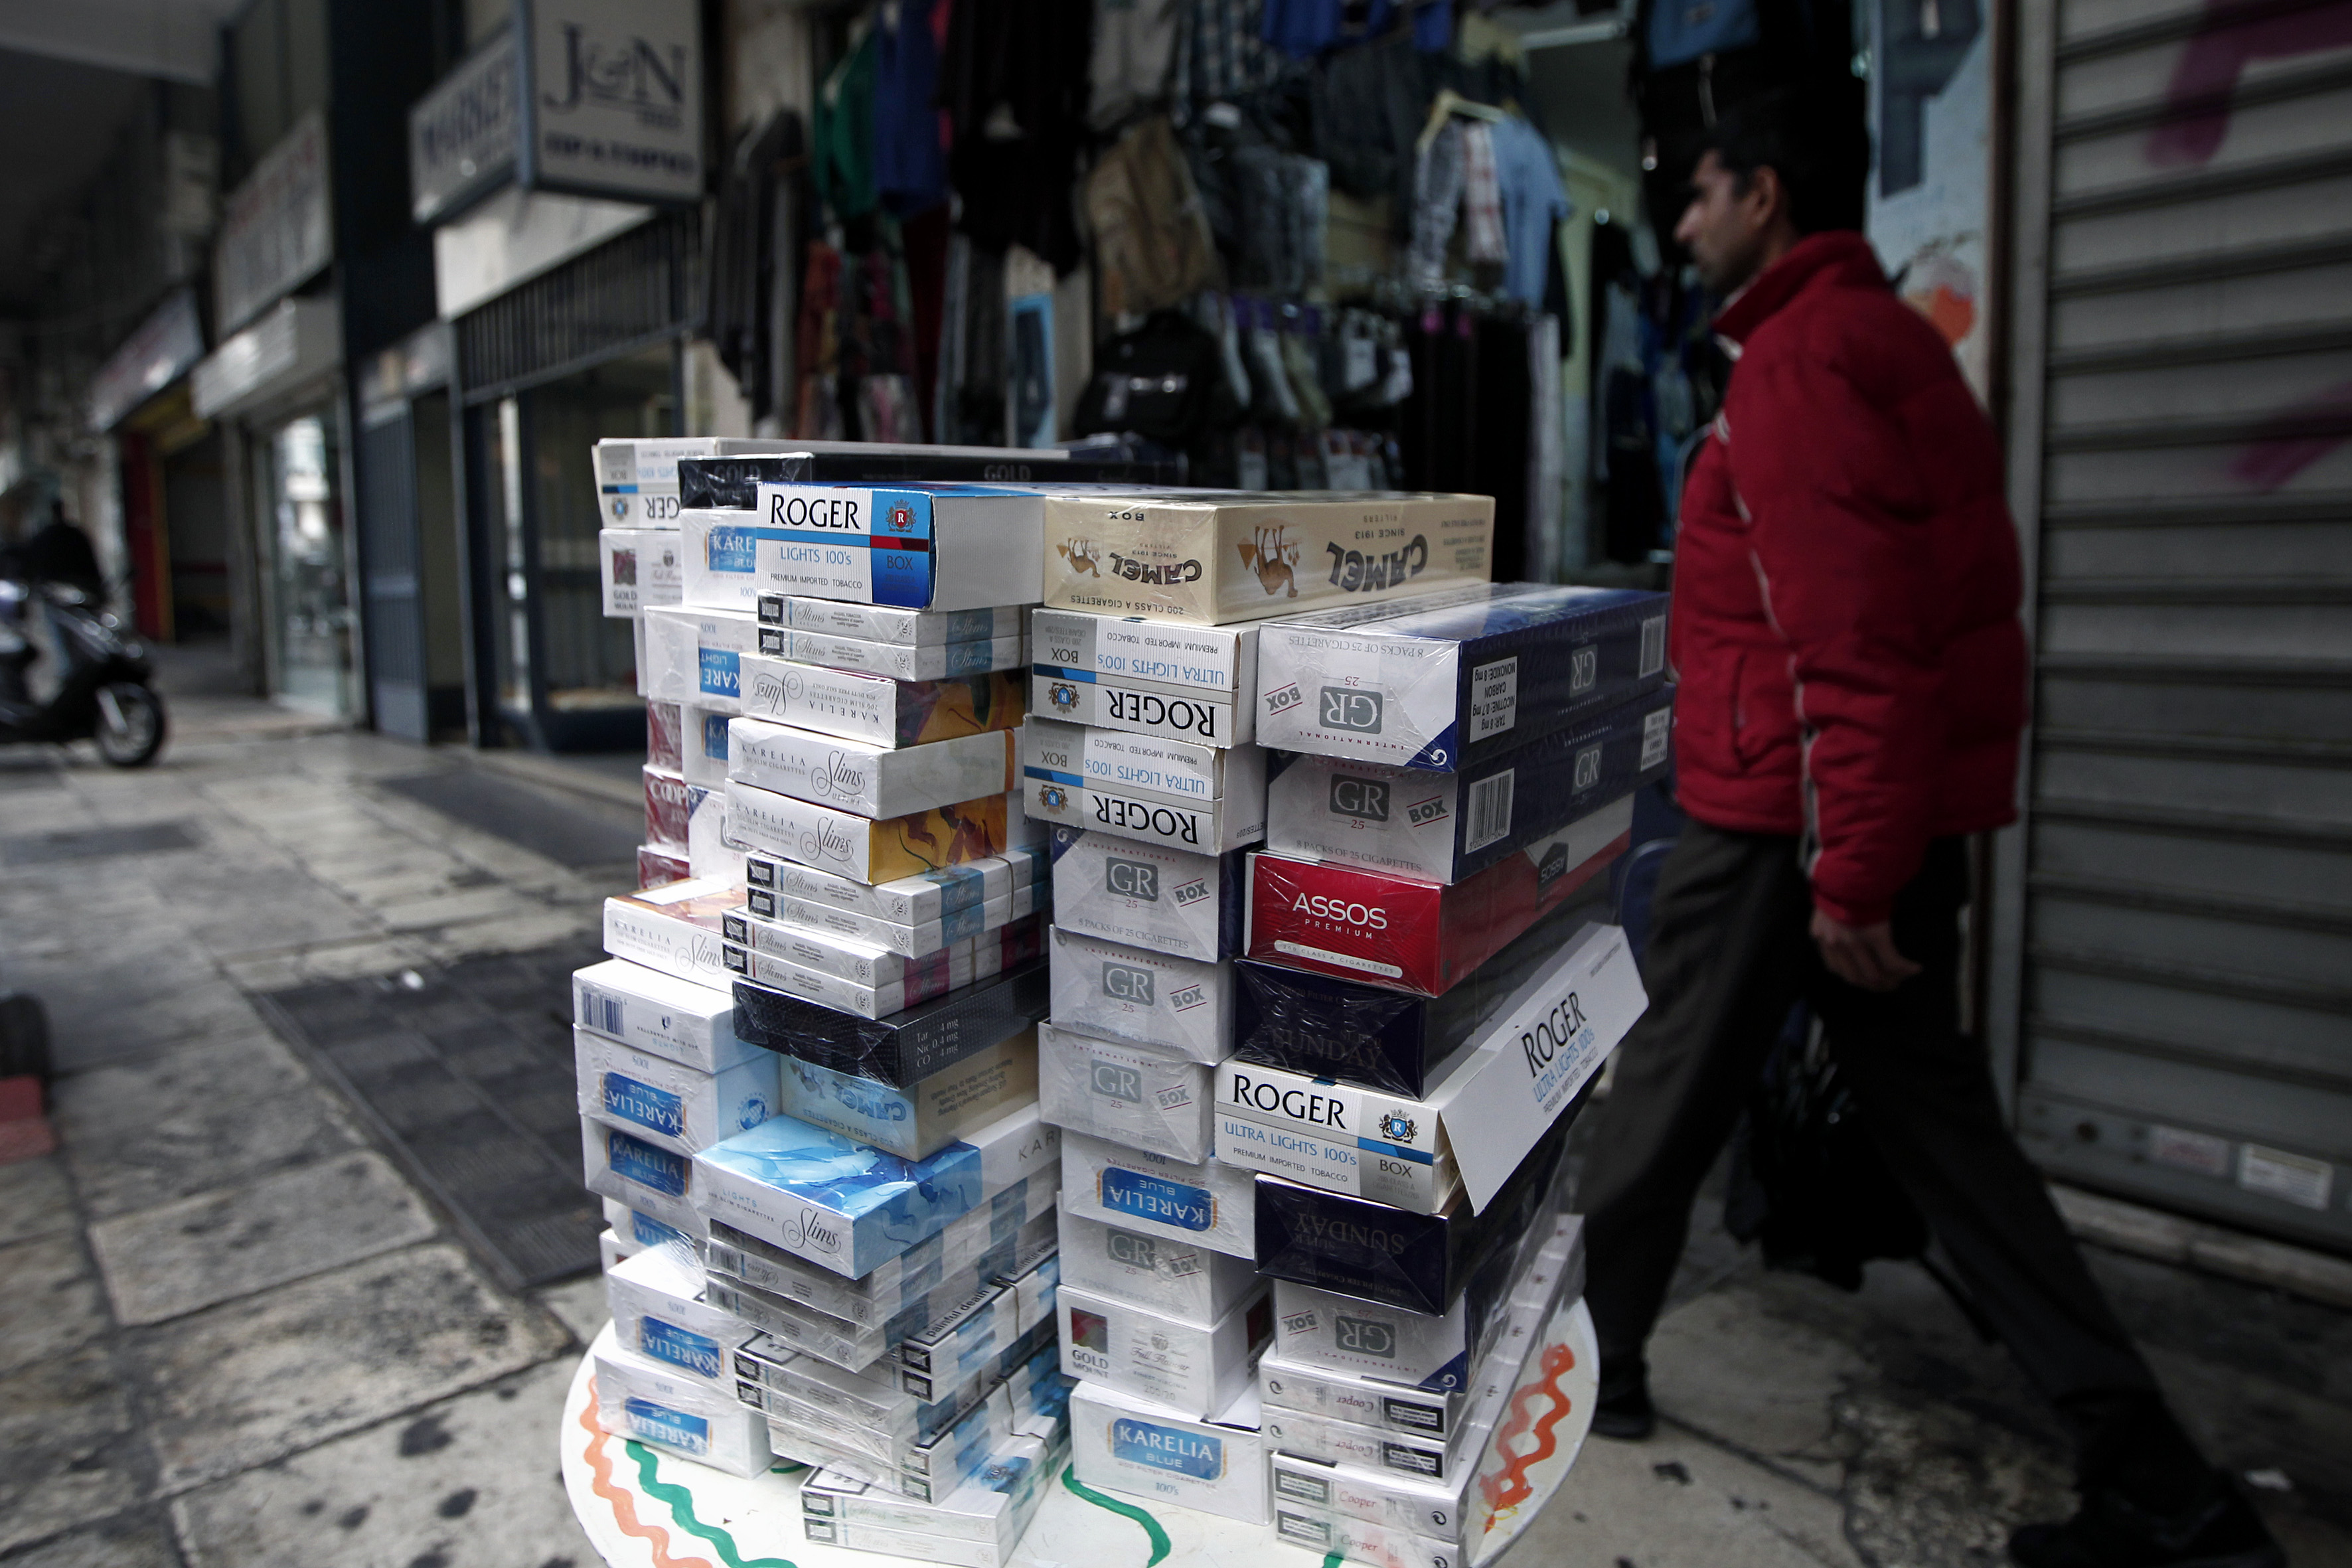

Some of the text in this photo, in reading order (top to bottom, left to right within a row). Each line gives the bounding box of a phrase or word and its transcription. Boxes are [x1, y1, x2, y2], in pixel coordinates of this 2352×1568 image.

[984, 464, 1031, 481] GOLD
[770, 493, 861, 530] ROGER
[1110, 512, 1145, 521] BOX
[1355, 528, 1405, 540] SINCE 1913
[780, 546, 852, 565] LIGHTS 100's
[886, 555, 914, 570] BOX
[1326, 533, 1429, 592] CAMEL
[1109, 552, 1203, 585] CAMEL
[770, 573, 862, 589] PREMIUM IMPORTED TOBACCO
[1070, 594, 1123, 607] CIGARETTES
[1135, 603, 1164, 612] CLASS
[1166, 605, 1184, 615] 200
[1051, 647, 1079, 663] BOX
[1107, 631, 1219, 655] PREMIUM IMPORTED TOBACCO
[1289, 635, 1424, 658] 8 PACKS OF 25 CIGARETTES
[1097, 653, 1225, 685] ULTRA LIGHTS 100's
[1488, 662, 1516, 678] MONOXIDE:
[1572, 651, 1597, 690] GR
[752, 670, 804, 716] Slims
[1344, 676, 1360, 687] 25
[1484, 681, 1507, 696] CARBON
[809, 691, 848, 706] CIGARETTES
[1265, 686, 1302, 712] BOX
[1324, 691, 1378, 728] GR
[1490, 696, 1516, 715] NICOTINE:
[808, 700, 880, 724] KARELIA
[1105, 690, 1216, 738] ROGER
[1494, 714, 1506, 727] TAR:
[1094, 739, 1198, 765] PREMIUM IMPORTED TOBACCO
[1298, 730, 1405, 751] INTERNATIONAL
[742, 744, 806, 767] KARELIA
[1042, 751, 1067, 767] BOX
[769, 761, 806, 776] CIGARETTES
[811, 750, 866, 797] Slims
[1085, 758, 1206, 794] ULTRA LIGHTS 100's
[1575, 751, 1601, 789] GR
[1333, 779, 1385, 817] GR
[736, 801, 795, 830] KARELIA
[1092, 794, 1199, 845] ROGER
[1408, 799, 1449, 823] BOX
[1350, 819, 1366, 830] 25
[800, 816, 854, 862] Slims
[1087, 841, 1176, 862] INTERNATIONAL
[1303, 840, 1423, 872] PACKS OF 25 CIGARETTES
[1110, 862, 1156, 898] GR
[1125, 899, 1138, 909] 25
[1175, 882, 1209, 903] BOX
[1292, 892, 1388, 930] ASSOS
[1084, 919, 1189, 949] PACKS OF 25 CIGARETTES
[1304, 917, 1373, 939] PREMIUM
[674, 933, 723, 975] Slims
[1085, 947, 1173, 969] INTERNATIONAL
[1300, 947, 1394, 974] CLASS CIGARETTES
[1106, 967, 1150, 1002] GR
[1121, 1003, 1135, 1013] 25
[1171, 987, 1206, 1008] BOX
[916, 1018, 959, 1044] Tar mg
[1521, 990, 1587, 1079] ROGER
[916, 1031, 959, 1056] Nic 0.4 mg
[917, 1044, 959, 1068] CO mg
[1073, 1044, 1159, 1069] INTERNATIONAL
[1095, 1065, 1138, 1100] GR
[1533, 1071, 1557, 1103] ULTRA
[1555, 1042, 1579, 1080] LIGHTS
[831, 1080, 907, 1122] CAMEL
[1110, 1099, 1123, 1109] 25
[1158, 1087, 1190, 1107] BOX
[1232, 1073, 1347, 1130] ROGER
[607, 1089, 678, 1132] KARELIA
[854, 1127, 878, 1142] CLASS
[1225, 1121, 1358, 1166] ULTRA LIGHTS 100's
[613, 1139, 679, 1180] KARELIA
[1143, 1150, 1166, 1165] 100's
[1233, 1146, 1348, 1182] PREMIUM IMPORTED TOBACCO
[1379, 1158, 1413, 1179] BOX
[722, 1188, 758, 1208] LIGHTS
[1139, 1179, 1176, 1196] BLUE
[1109, 1185, 1204, 1224] KARELIA
[781, 1207, 842, 1255] Slims
[1294, 1212, 1406, 1255] SUNDAY
[1110, 1234, 1152, 1266] GR
[1125, 1265, 1137, 1275] 25
[925, 1289, 990, 1338] painful death
[1283, 1313, 1318, 1332] BOX
[1339, 1318, 1391, 1354] GR
[646, 1333, 721, 1373] KARELIA
[1072, 1348, 1109, 1370] GOLD
[1316, 1350, 1418, 1373] INTERNATIONAL
[1073, 1362, 1109, 1379] MOUNT
[1336, 1395, 1375, 1413] Cooper
[1119, 1425, 1214, 1462] KARELIA
[1334, 1438, 1373, 1457] Cooper
[1145, 1452, 1184, 1468] BLUE
[1155, 1481, 1180, 1496] 100's
[1340, 1490, 1377, 1508] Cooper
[1340, 1534, 1379, 1553] Cooper
